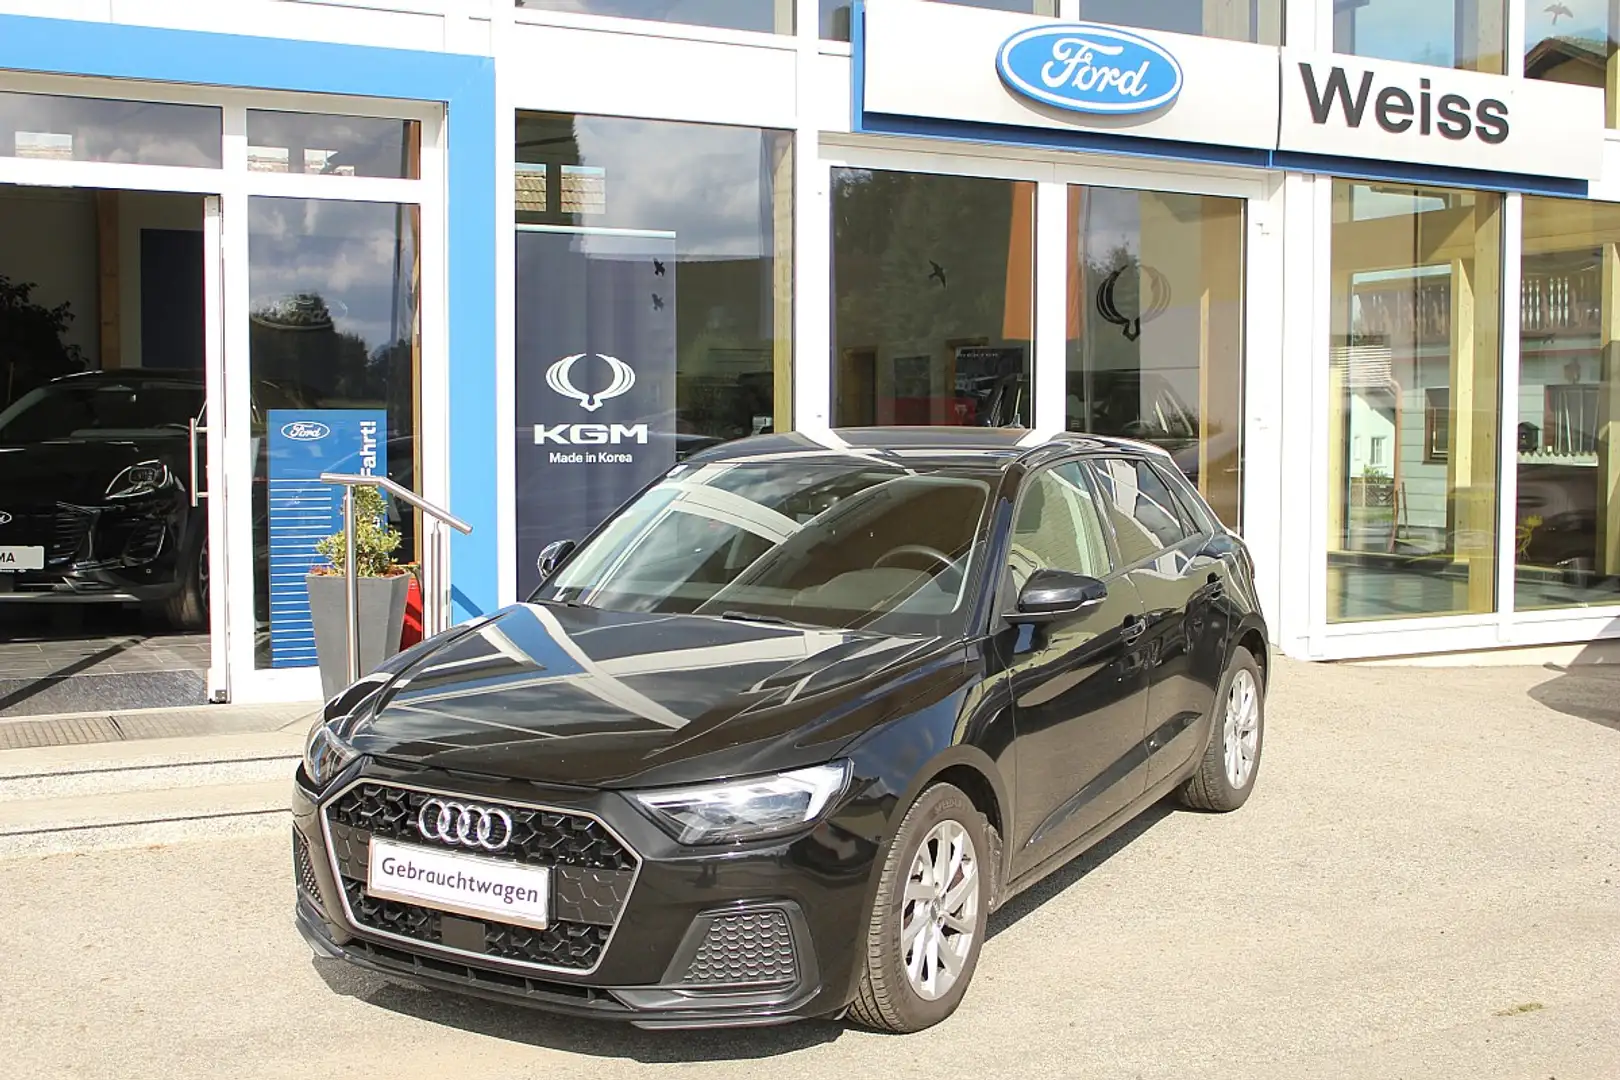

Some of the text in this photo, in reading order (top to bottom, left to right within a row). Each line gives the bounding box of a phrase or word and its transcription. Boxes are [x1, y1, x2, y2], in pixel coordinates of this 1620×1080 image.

[1041, 38, 1150, 97] Ford
[1298, 62, 1509, 144] Weiss
[289, 423, 322, 438] Ford
[534, 423, 648, 445] KGM
[549, 452, 633, 463] Made in Korea
[382, 857, 538, 904] Gebrauchtwagen
